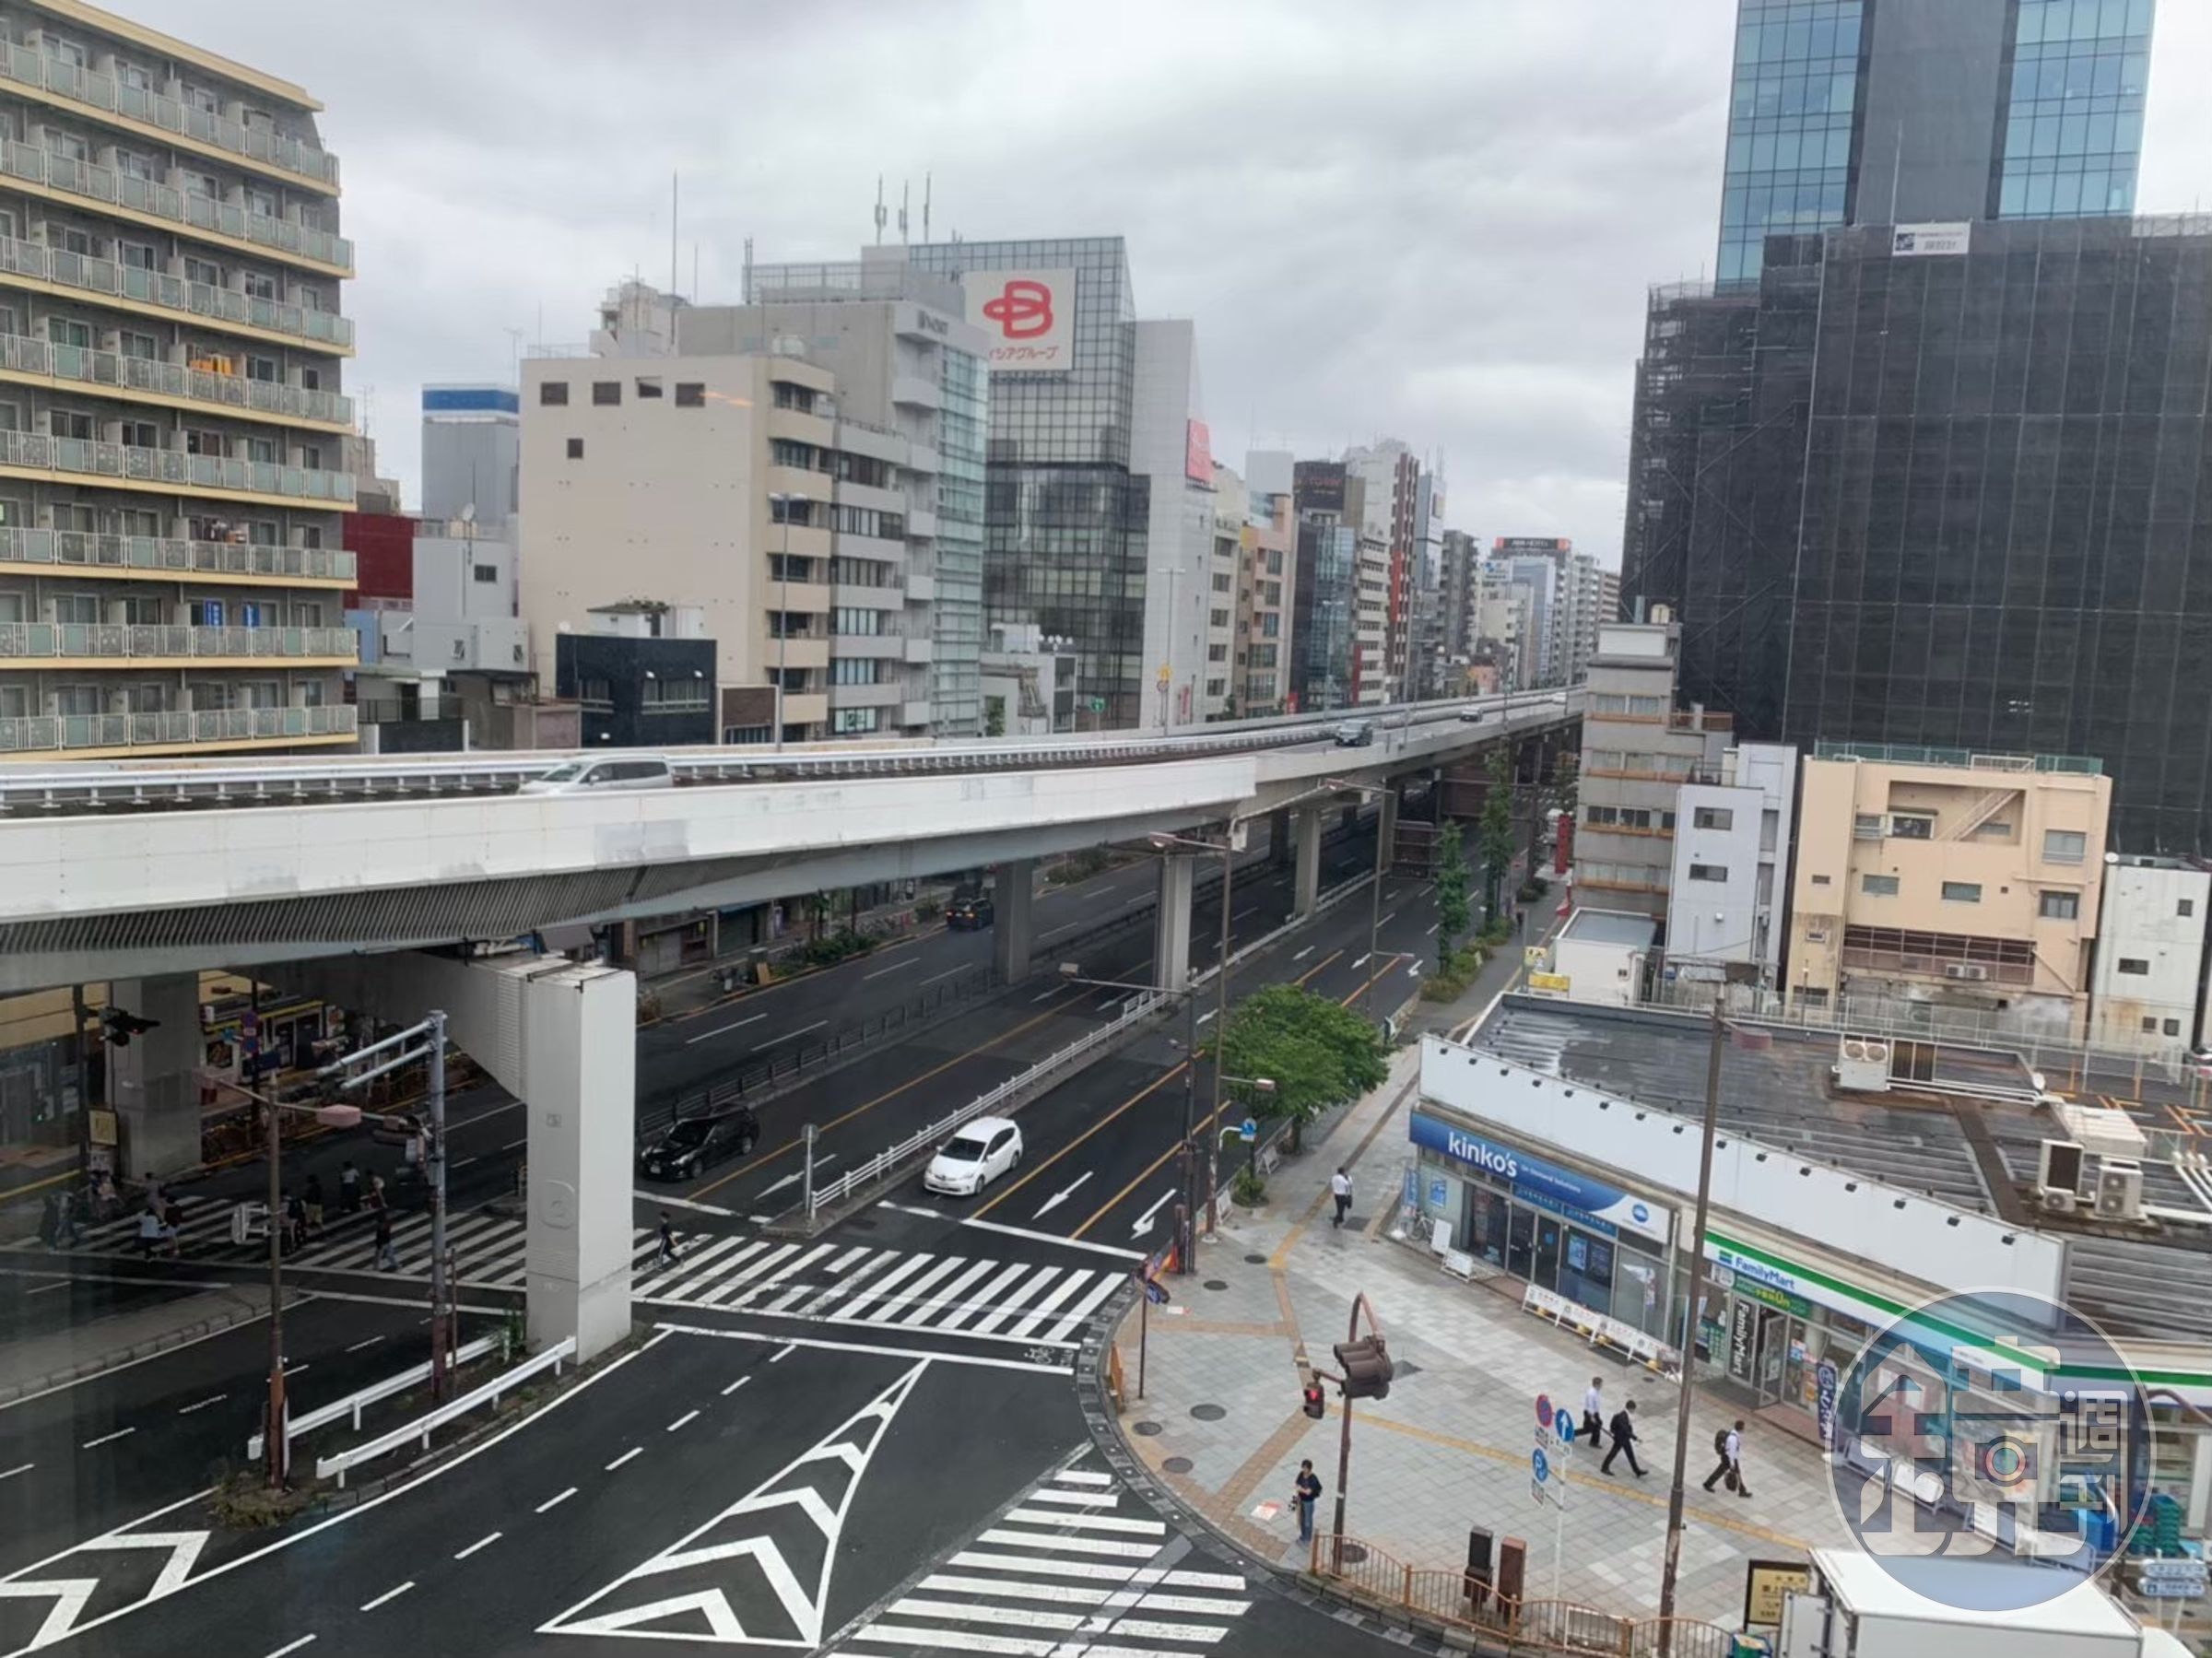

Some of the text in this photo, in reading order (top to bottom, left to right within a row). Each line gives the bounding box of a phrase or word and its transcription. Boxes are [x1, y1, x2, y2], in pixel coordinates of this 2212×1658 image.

[1448, 1131, 1518, 1178] kinko's
[1735, 1256, 1794, 1289] FamilyMart
[1734, 1301, 1750, 1375] FamilyMart
